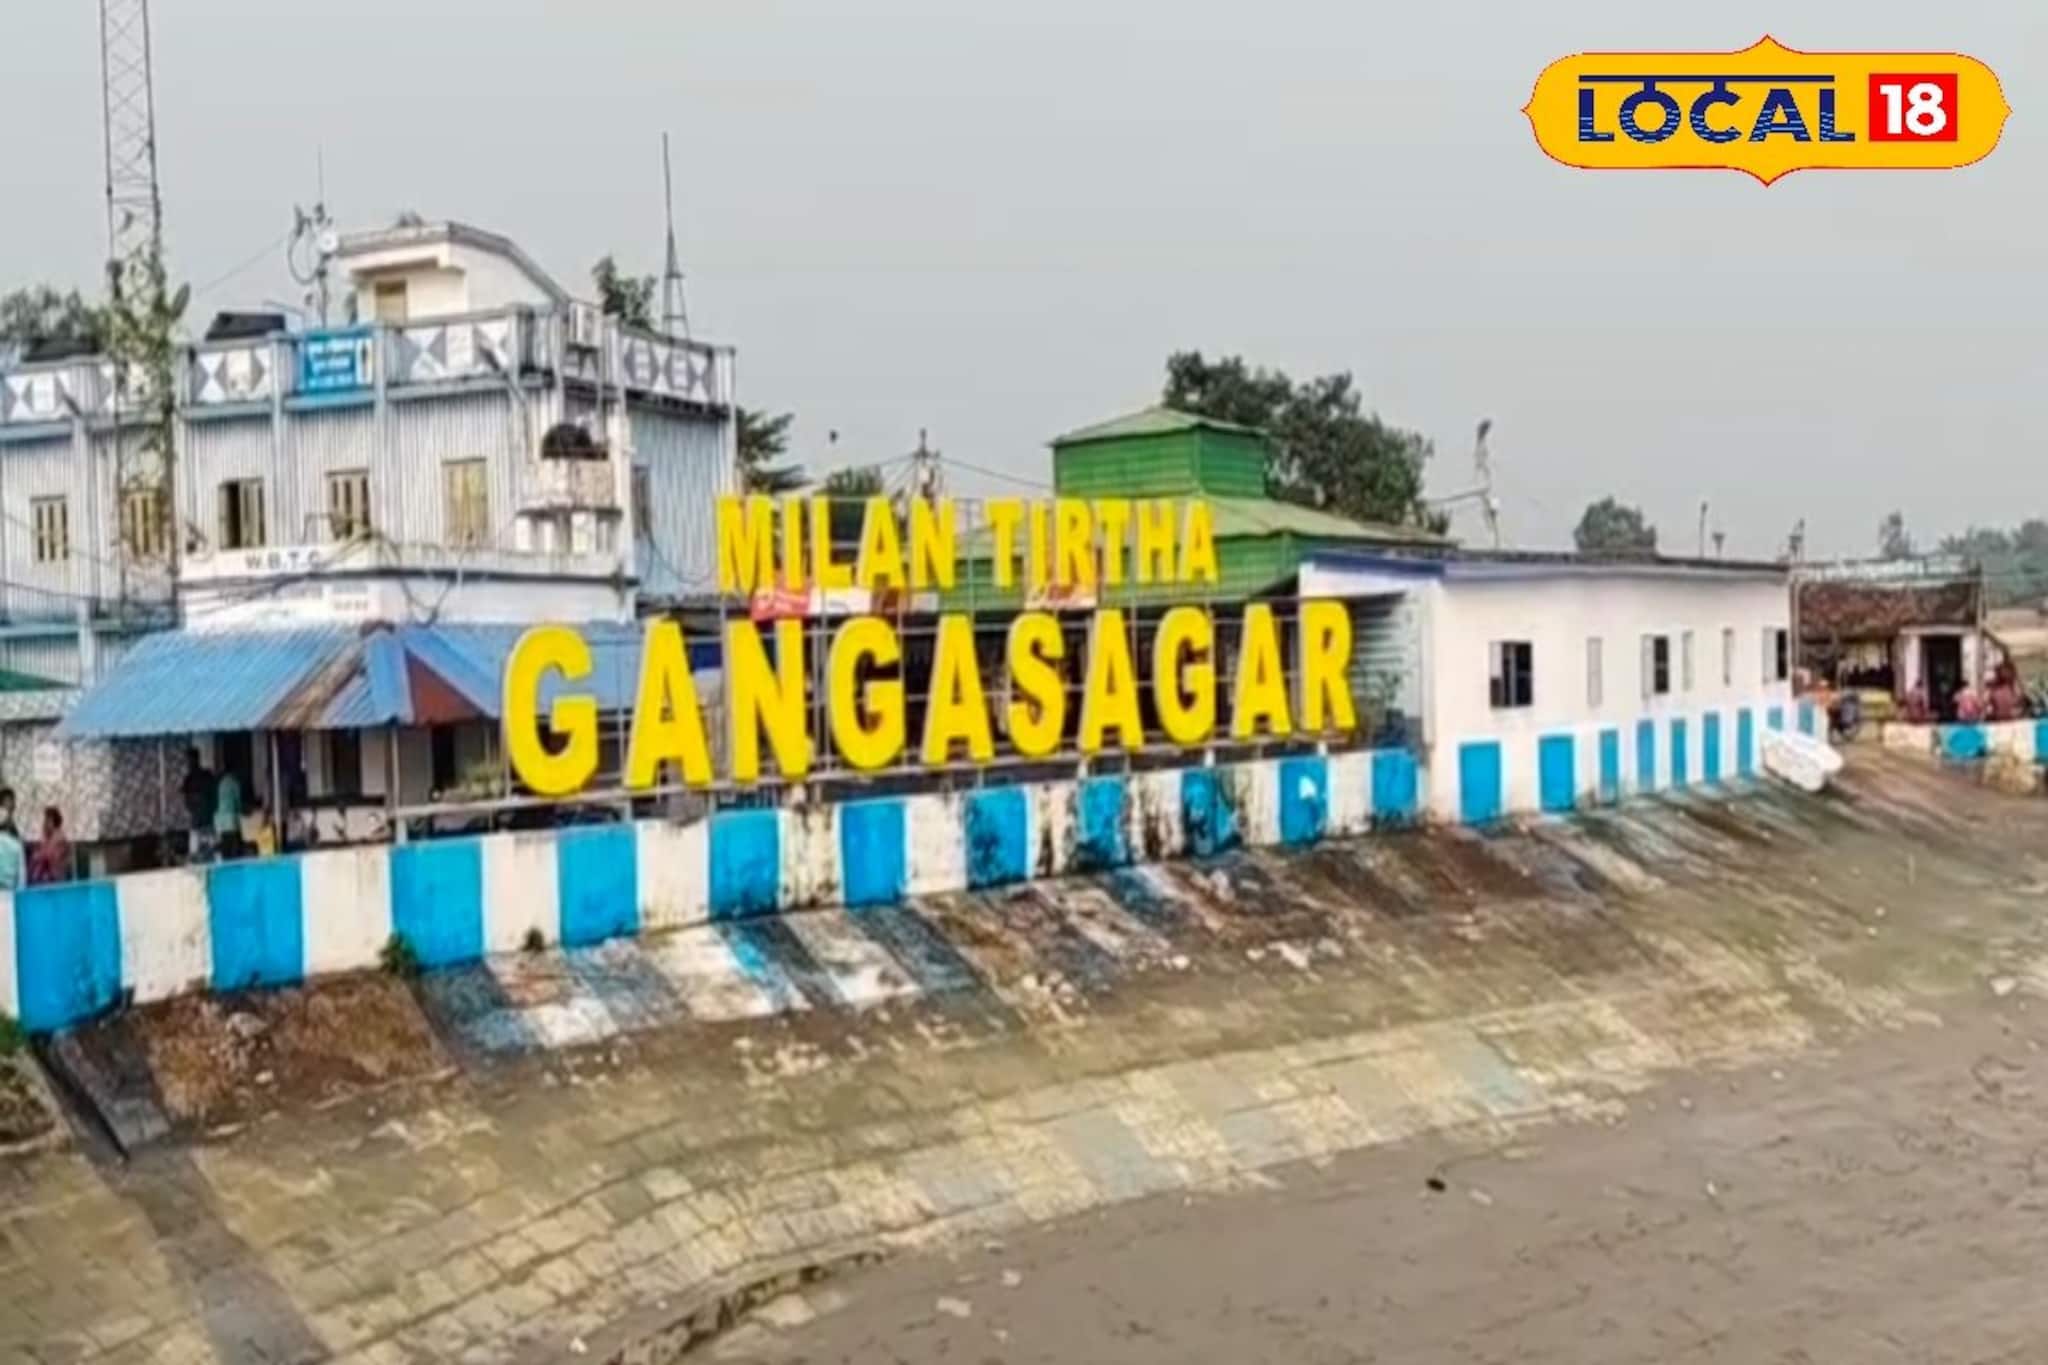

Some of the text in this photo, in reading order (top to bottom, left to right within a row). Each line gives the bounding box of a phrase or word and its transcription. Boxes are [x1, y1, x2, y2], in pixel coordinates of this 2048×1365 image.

[718, 497, 1219, 593] MILAN TIRTHA
[502, 599, 1357, 796] GANGASAGAR
